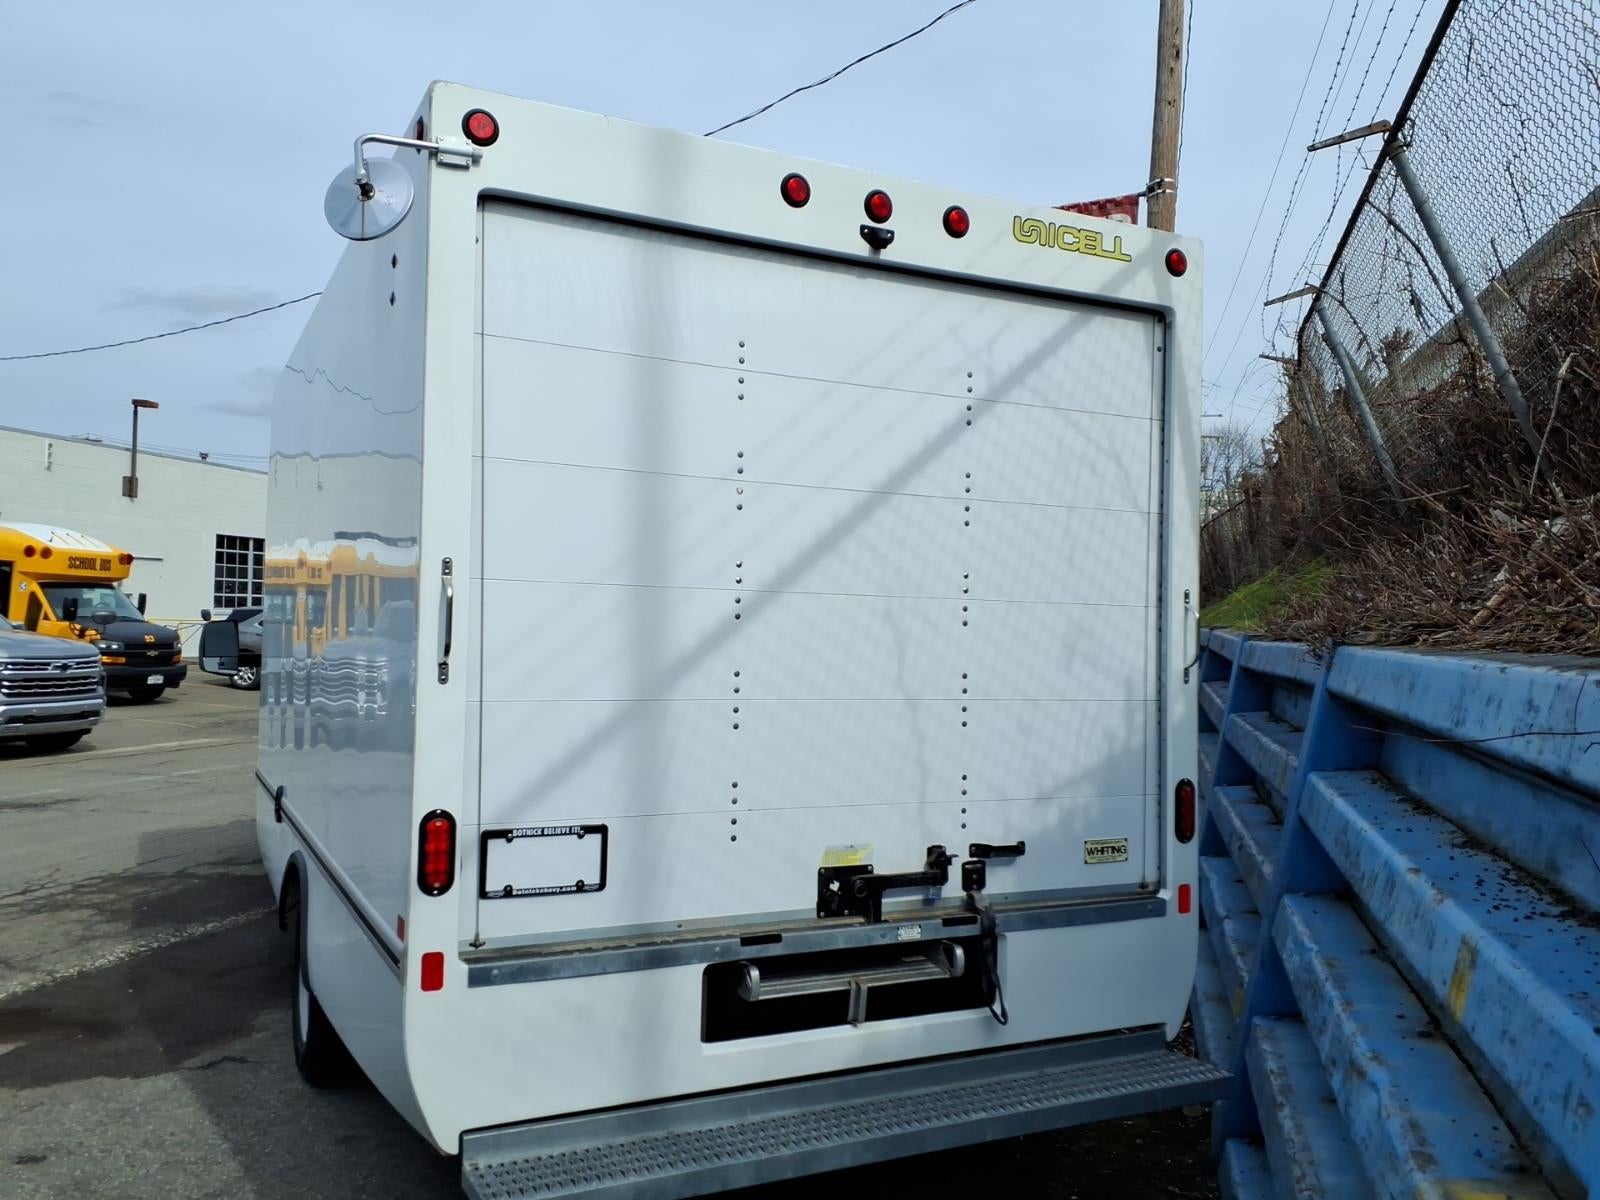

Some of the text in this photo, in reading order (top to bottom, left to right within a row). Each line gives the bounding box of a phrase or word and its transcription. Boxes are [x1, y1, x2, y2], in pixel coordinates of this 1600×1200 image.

[1012, 215, 1132, 262] UNICELL
[68, 556, 112, 571] SCHOOL BUS
[512, 829, 542, 837] BOTNICK
[543, 827, 570, 835] BELIEVE
[1086, 844, 1127, 856] WHITING
